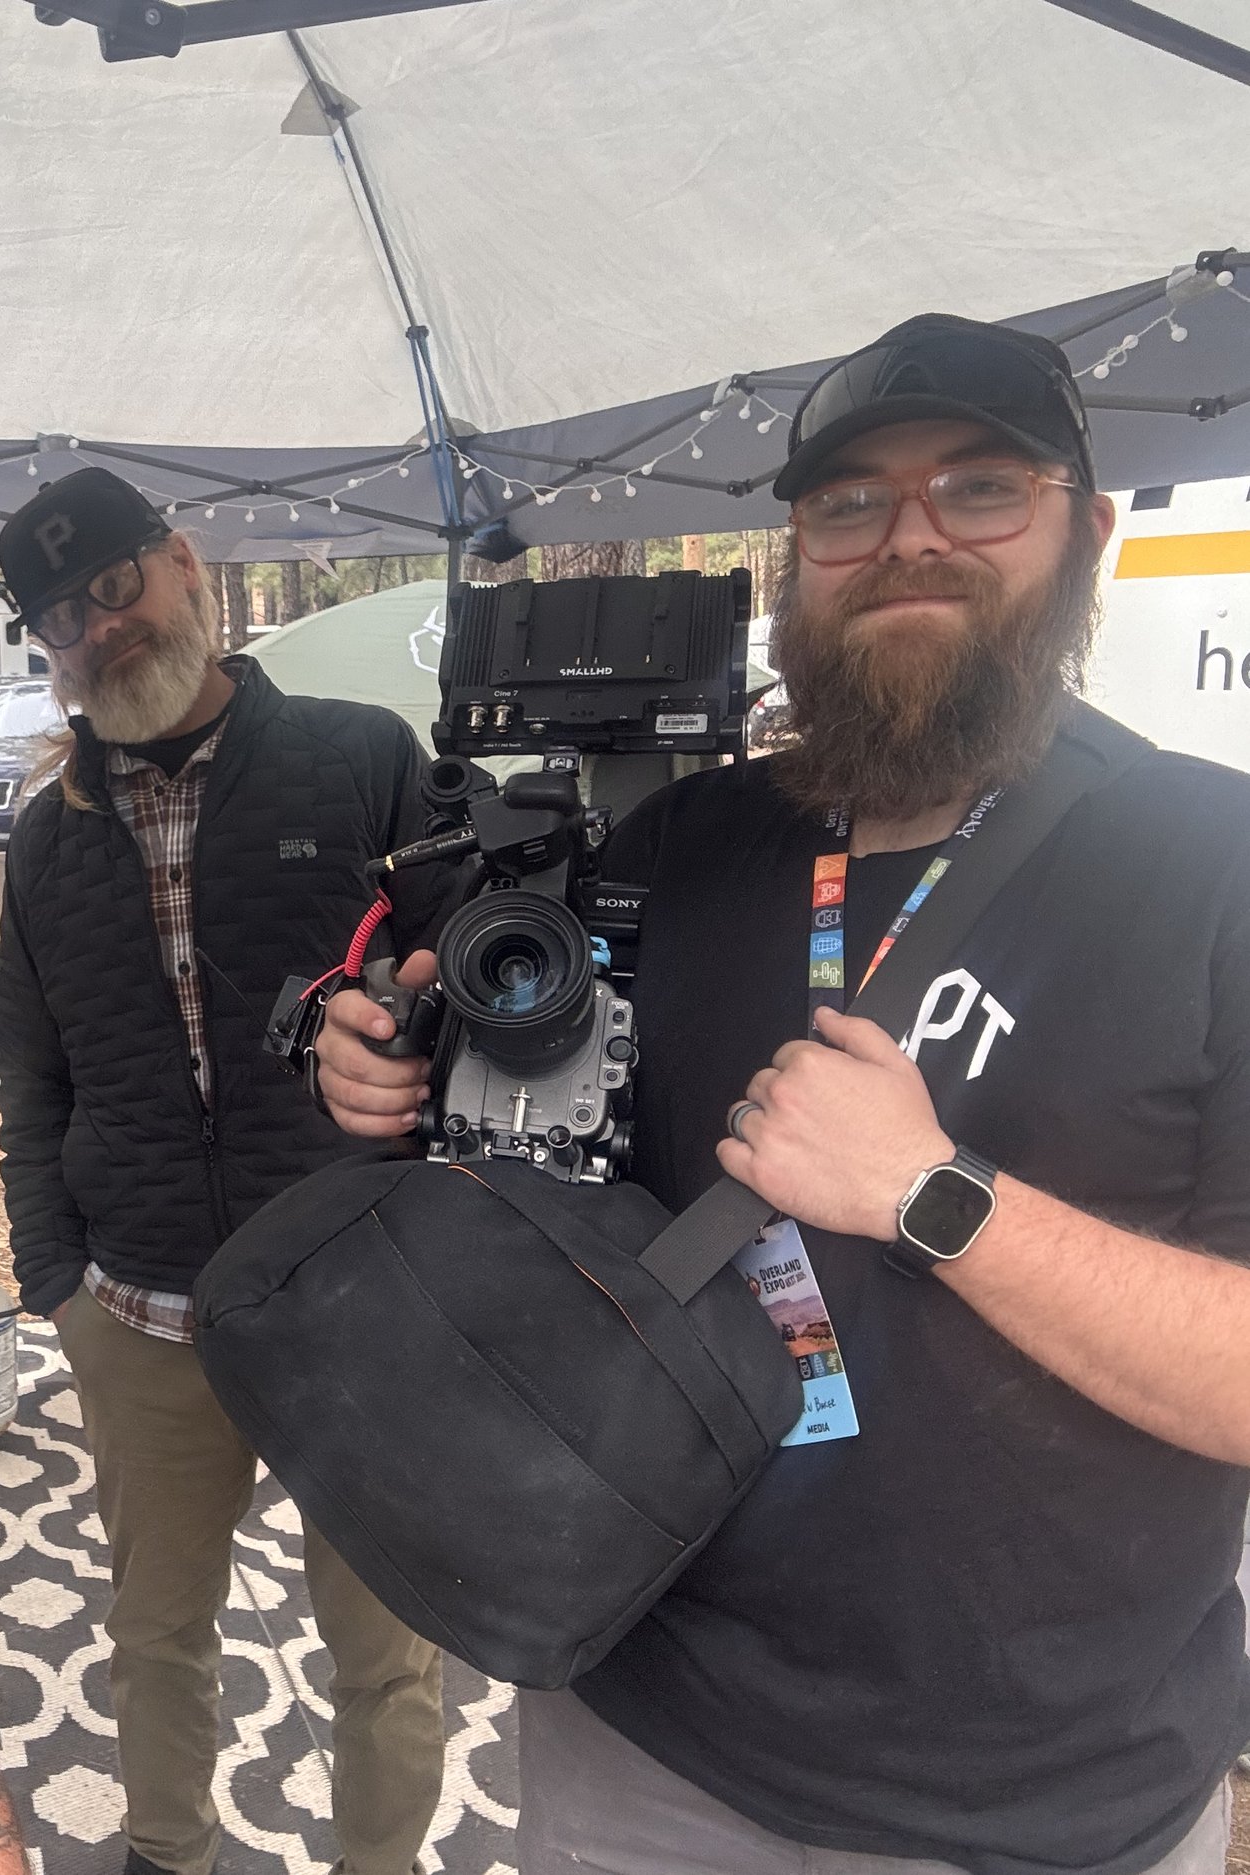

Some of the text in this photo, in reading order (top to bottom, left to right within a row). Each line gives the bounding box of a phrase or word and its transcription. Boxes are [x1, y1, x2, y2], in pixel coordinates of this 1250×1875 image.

[34, 512, 77, 571] P
[1196, 629, 1250, 690] h
[559, 666, 613, 677] SMALLHD
[596, 897, 642, 909] SONY
[759, 1258, 802, 1281] OVERLAND
[763, 1278, 786, 1294] EXPO
[807, 1422, 830, 1434] MEDIA
